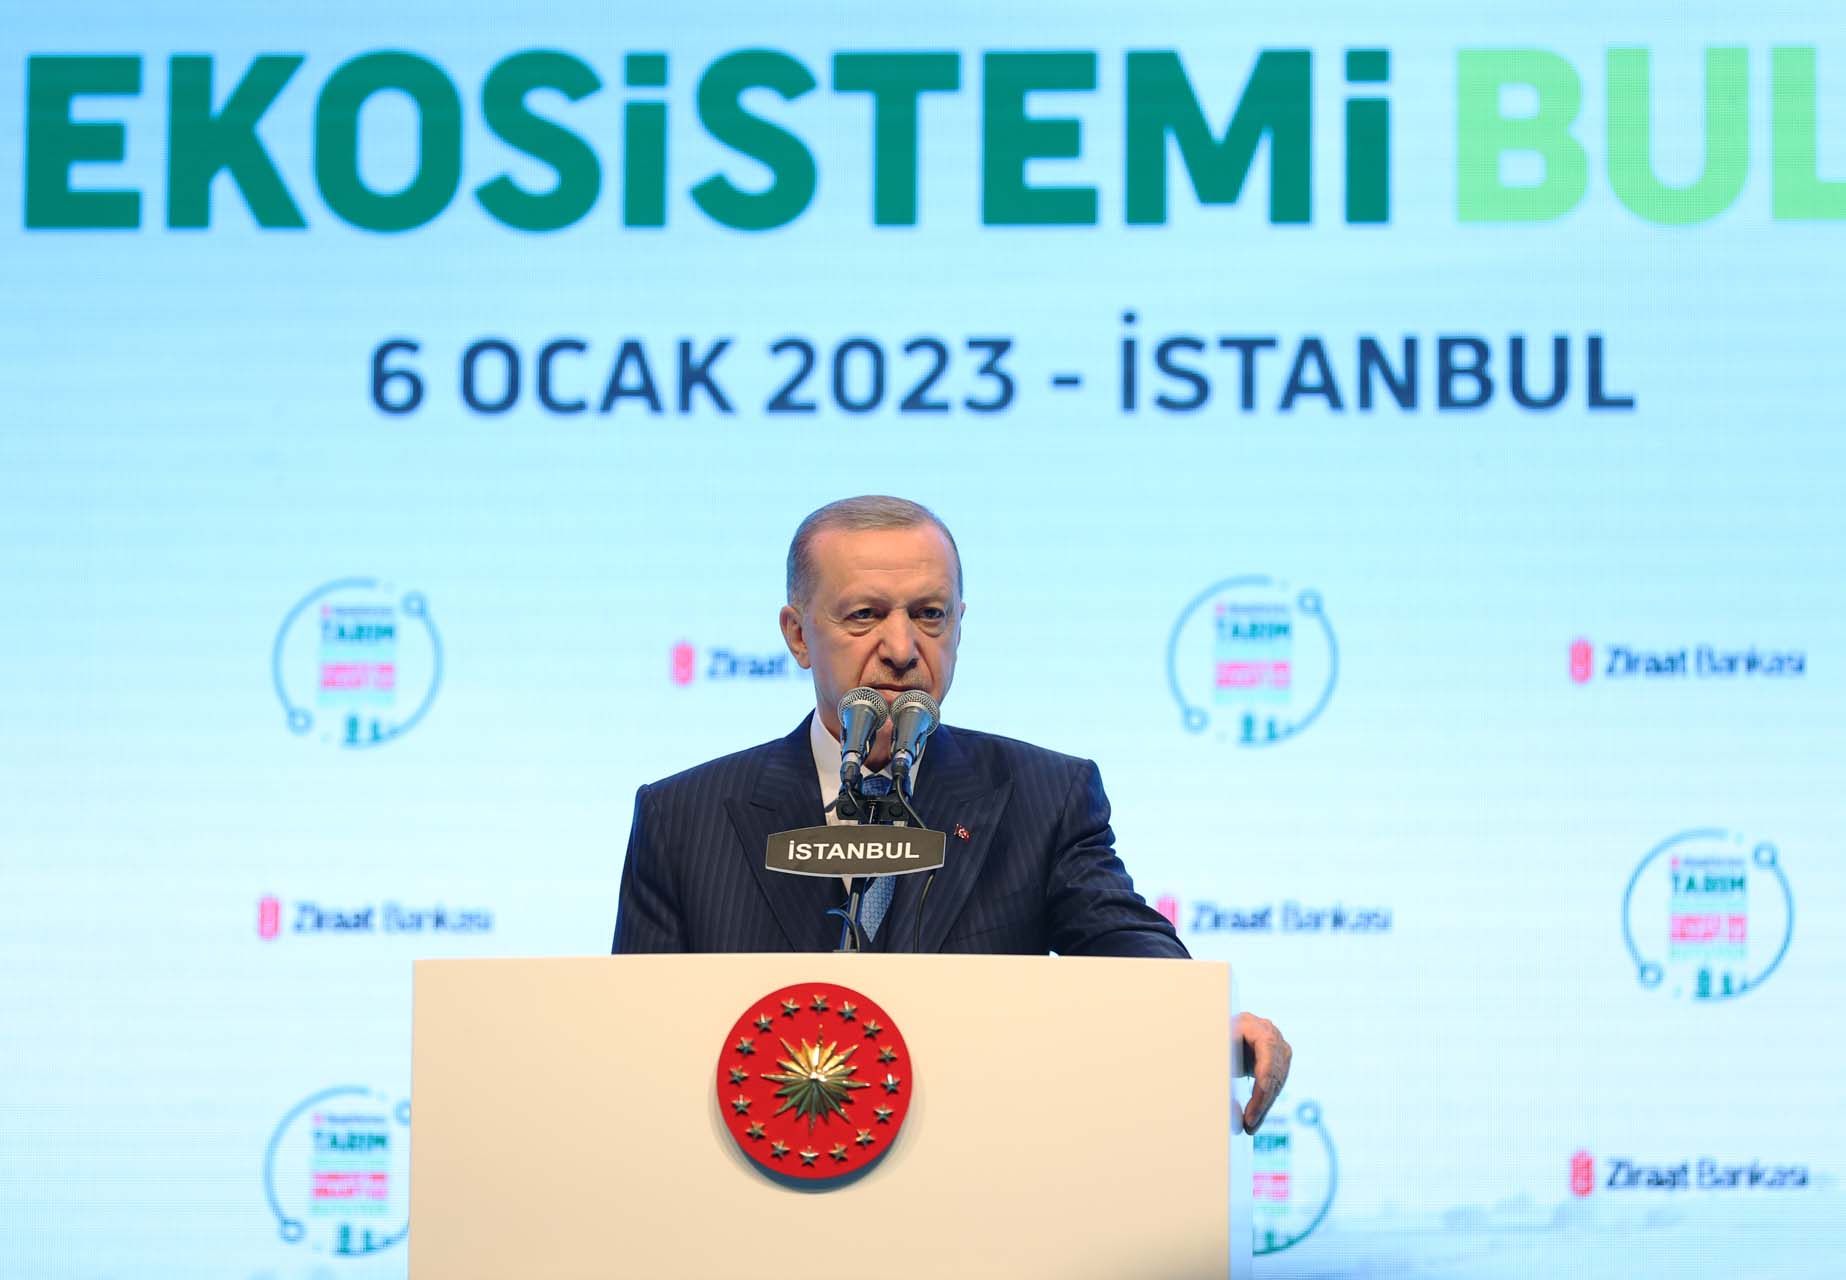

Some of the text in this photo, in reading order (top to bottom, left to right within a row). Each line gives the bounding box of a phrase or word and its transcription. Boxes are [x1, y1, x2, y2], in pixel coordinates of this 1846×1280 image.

[1456, 46, 1846, 226] BUL
[372, 338, 425, 415] 6
[461, 337, 735, 415] OCAK
[766, 336, 1016, 414] 2023
[1121, 310, 1637, 412] İSTANBUL
[788, 840, 920, 860] İSTANBUL
